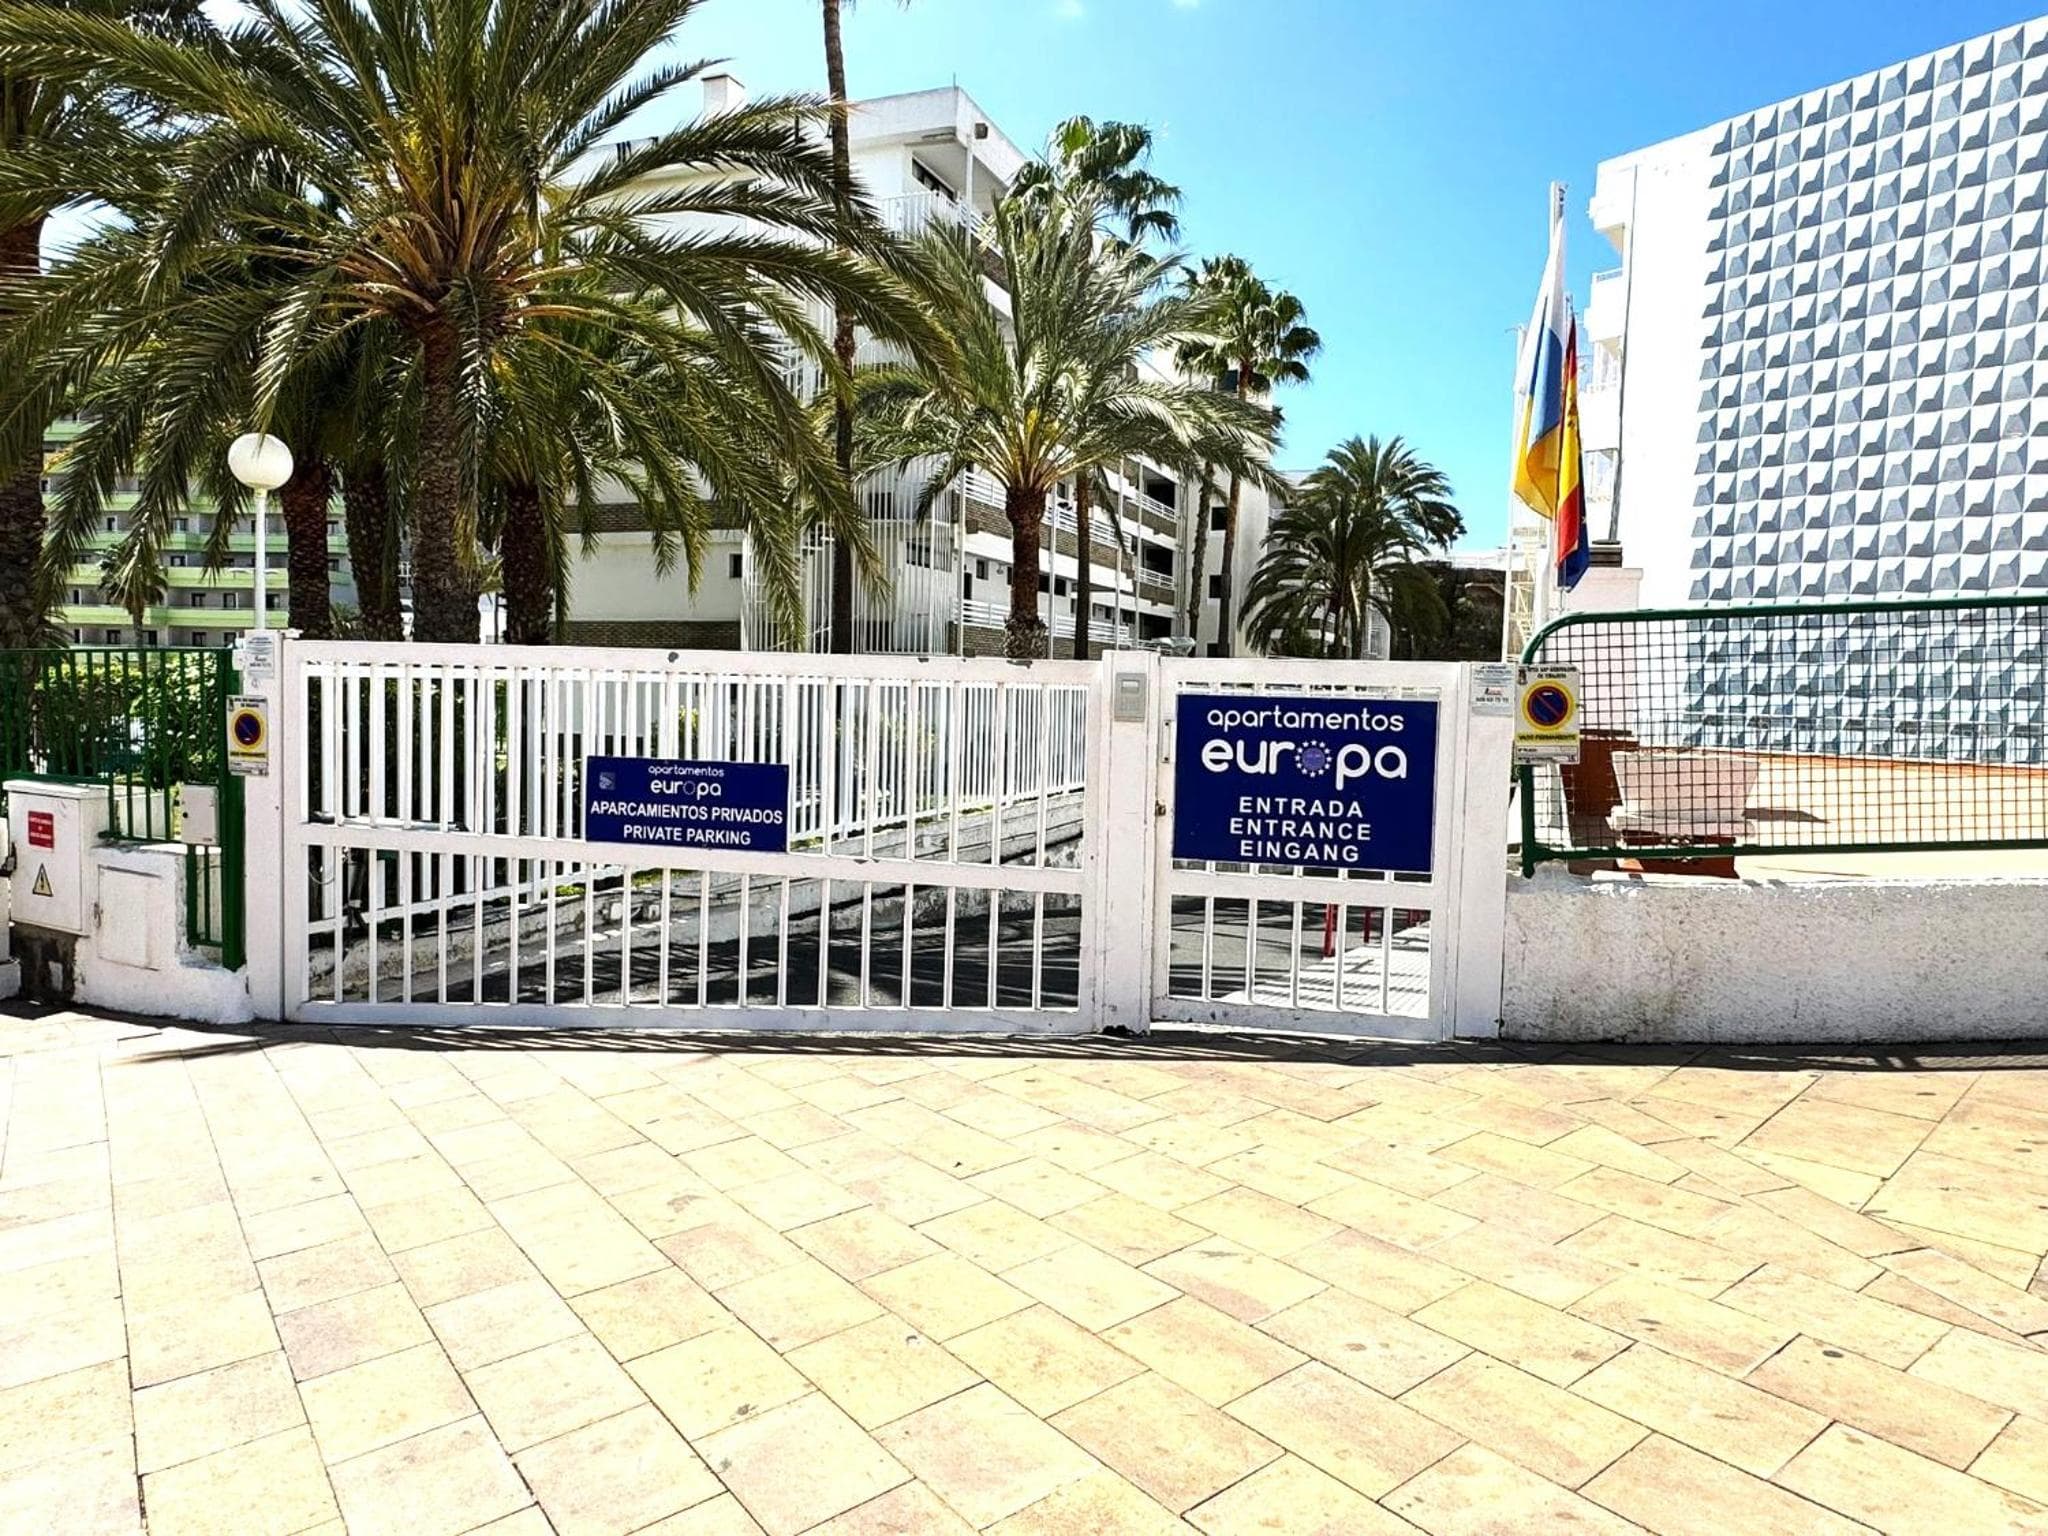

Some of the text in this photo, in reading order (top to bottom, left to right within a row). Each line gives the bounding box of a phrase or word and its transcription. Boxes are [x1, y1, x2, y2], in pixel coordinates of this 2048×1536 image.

[1207, 704, 1404, 733] apartamentos
[647, 764, 725, 777] apartamentos
[1201, 738, 1407, 791] europa
[650, 779, 722, 801] europa
[590, 800, 784, 825] APARCAMIENTOS PRIVADOS
[1239, 796, 1363, 818] ENTRADA
[623, 824, 751, 846] PRIVATE PARKING
[1230, 817, 1371, 841] ENTRANCE
[1240, 839, 1359, 861] EINGANG
